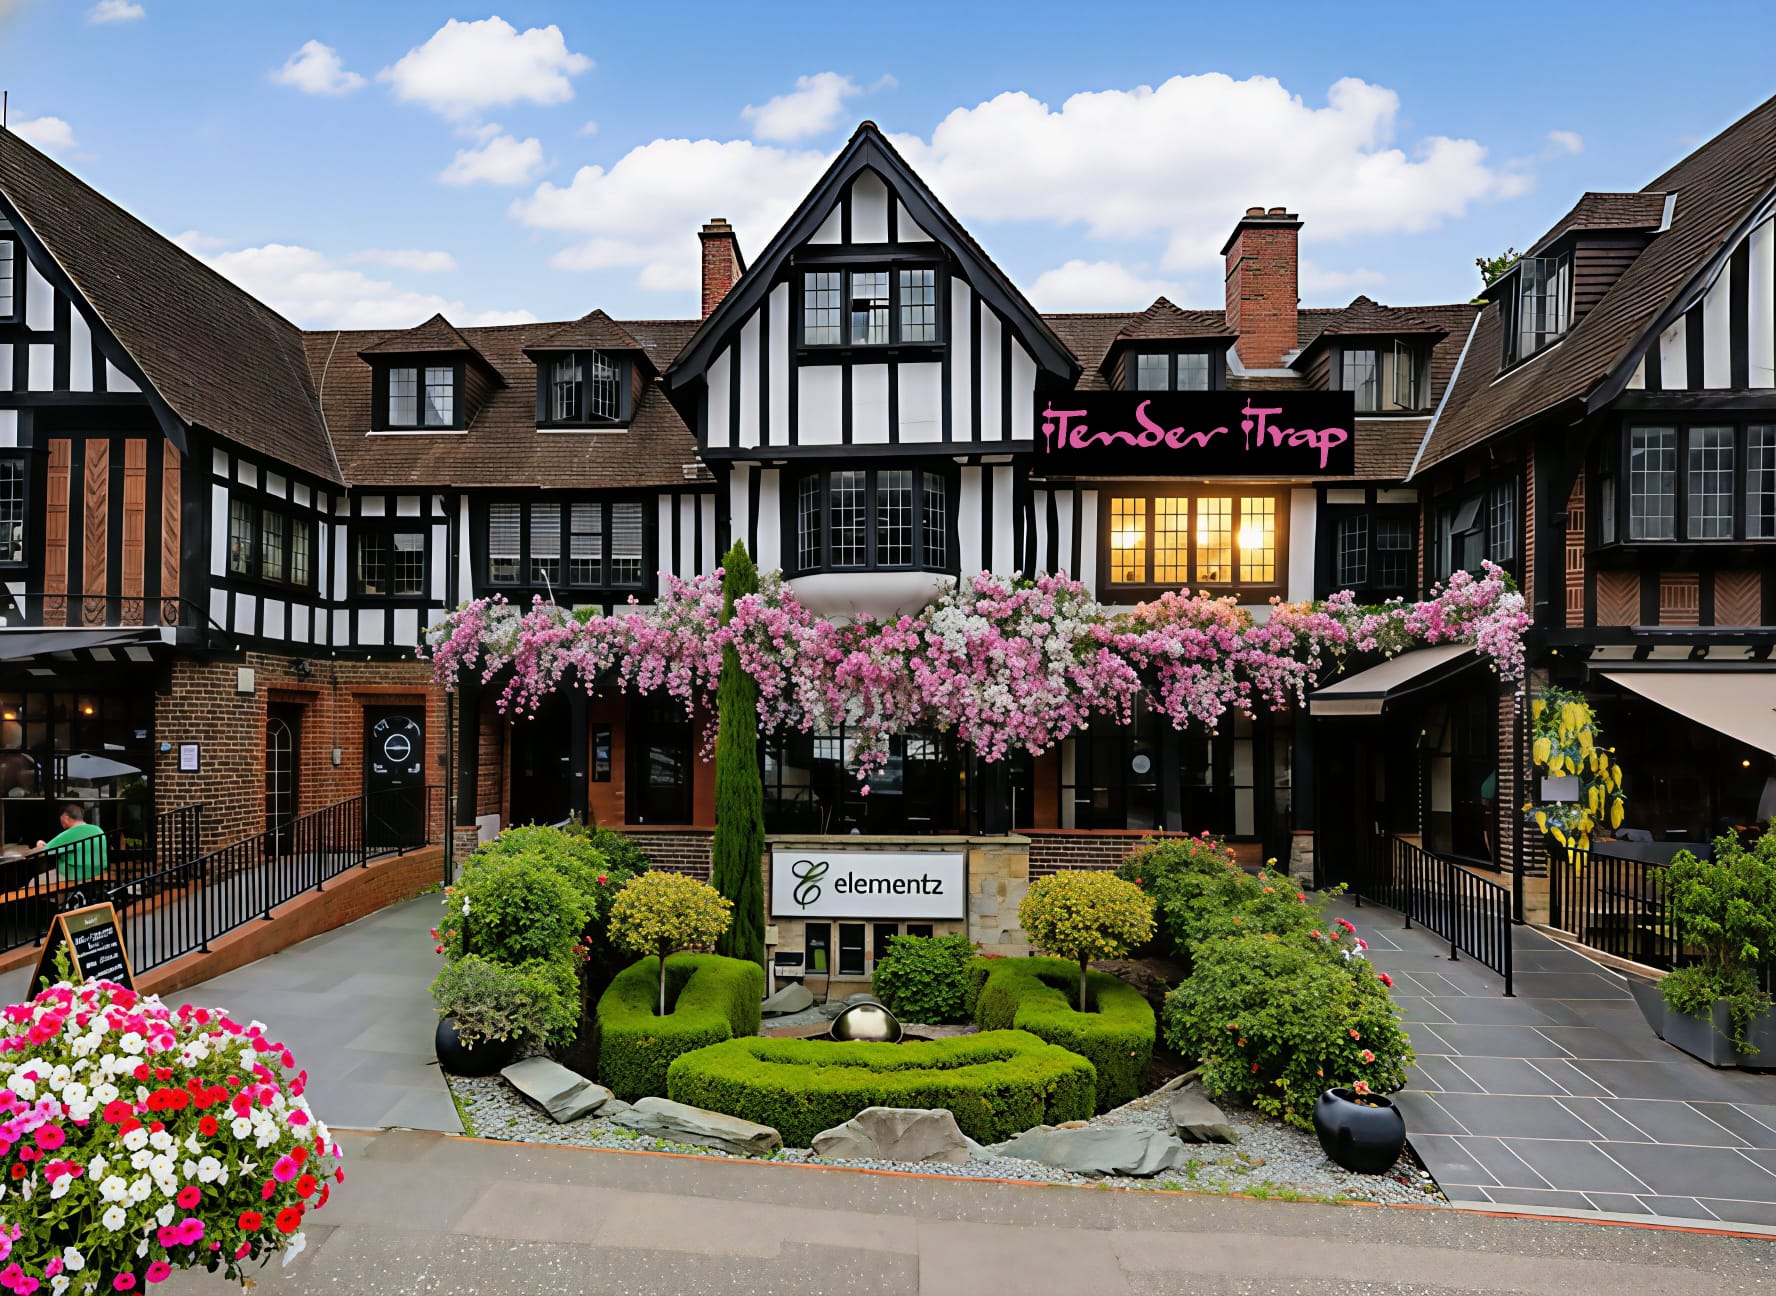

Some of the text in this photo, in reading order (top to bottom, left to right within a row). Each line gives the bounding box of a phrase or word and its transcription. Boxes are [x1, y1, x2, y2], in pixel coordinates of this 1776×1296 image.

[1042, 398, 1348, 468] Tender Trap
[834, 872, 943, 895] elementz
